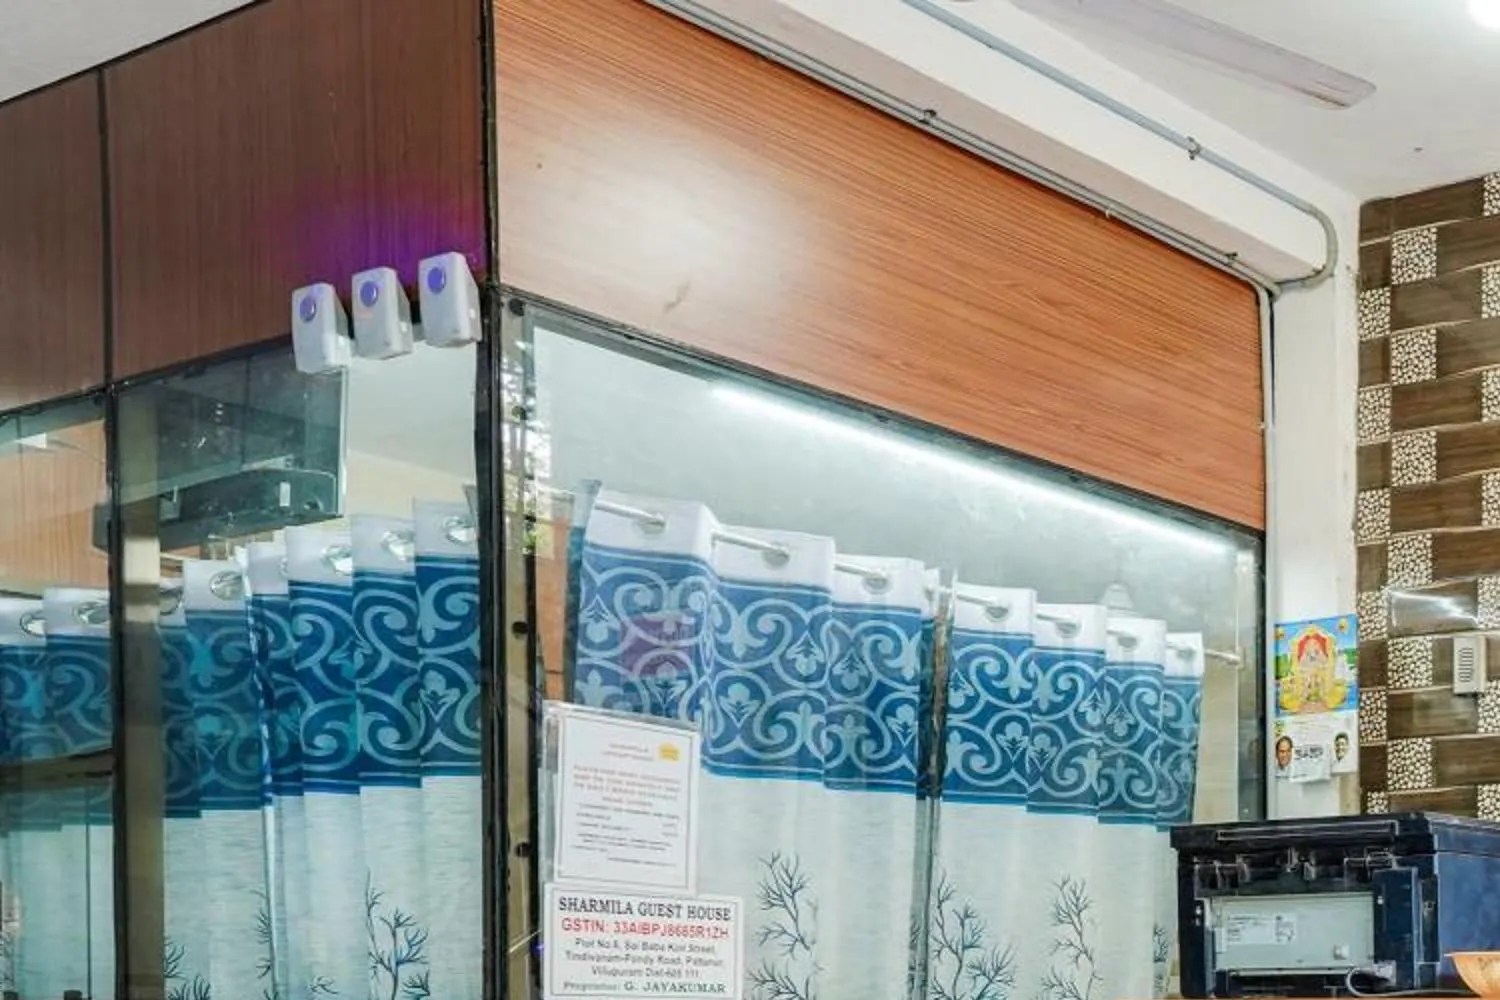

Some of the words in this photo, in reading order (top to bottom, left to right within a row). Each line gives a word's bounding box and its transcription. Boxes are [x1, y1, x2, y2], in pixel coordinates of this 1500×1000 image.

[559, 897, 633, 915] SHARMILA
[638, 902, 682, 917] GUEST
[688, 905, 730, 921] HOUSE
[643, 982, 725, 994] JAYAKUMAR
